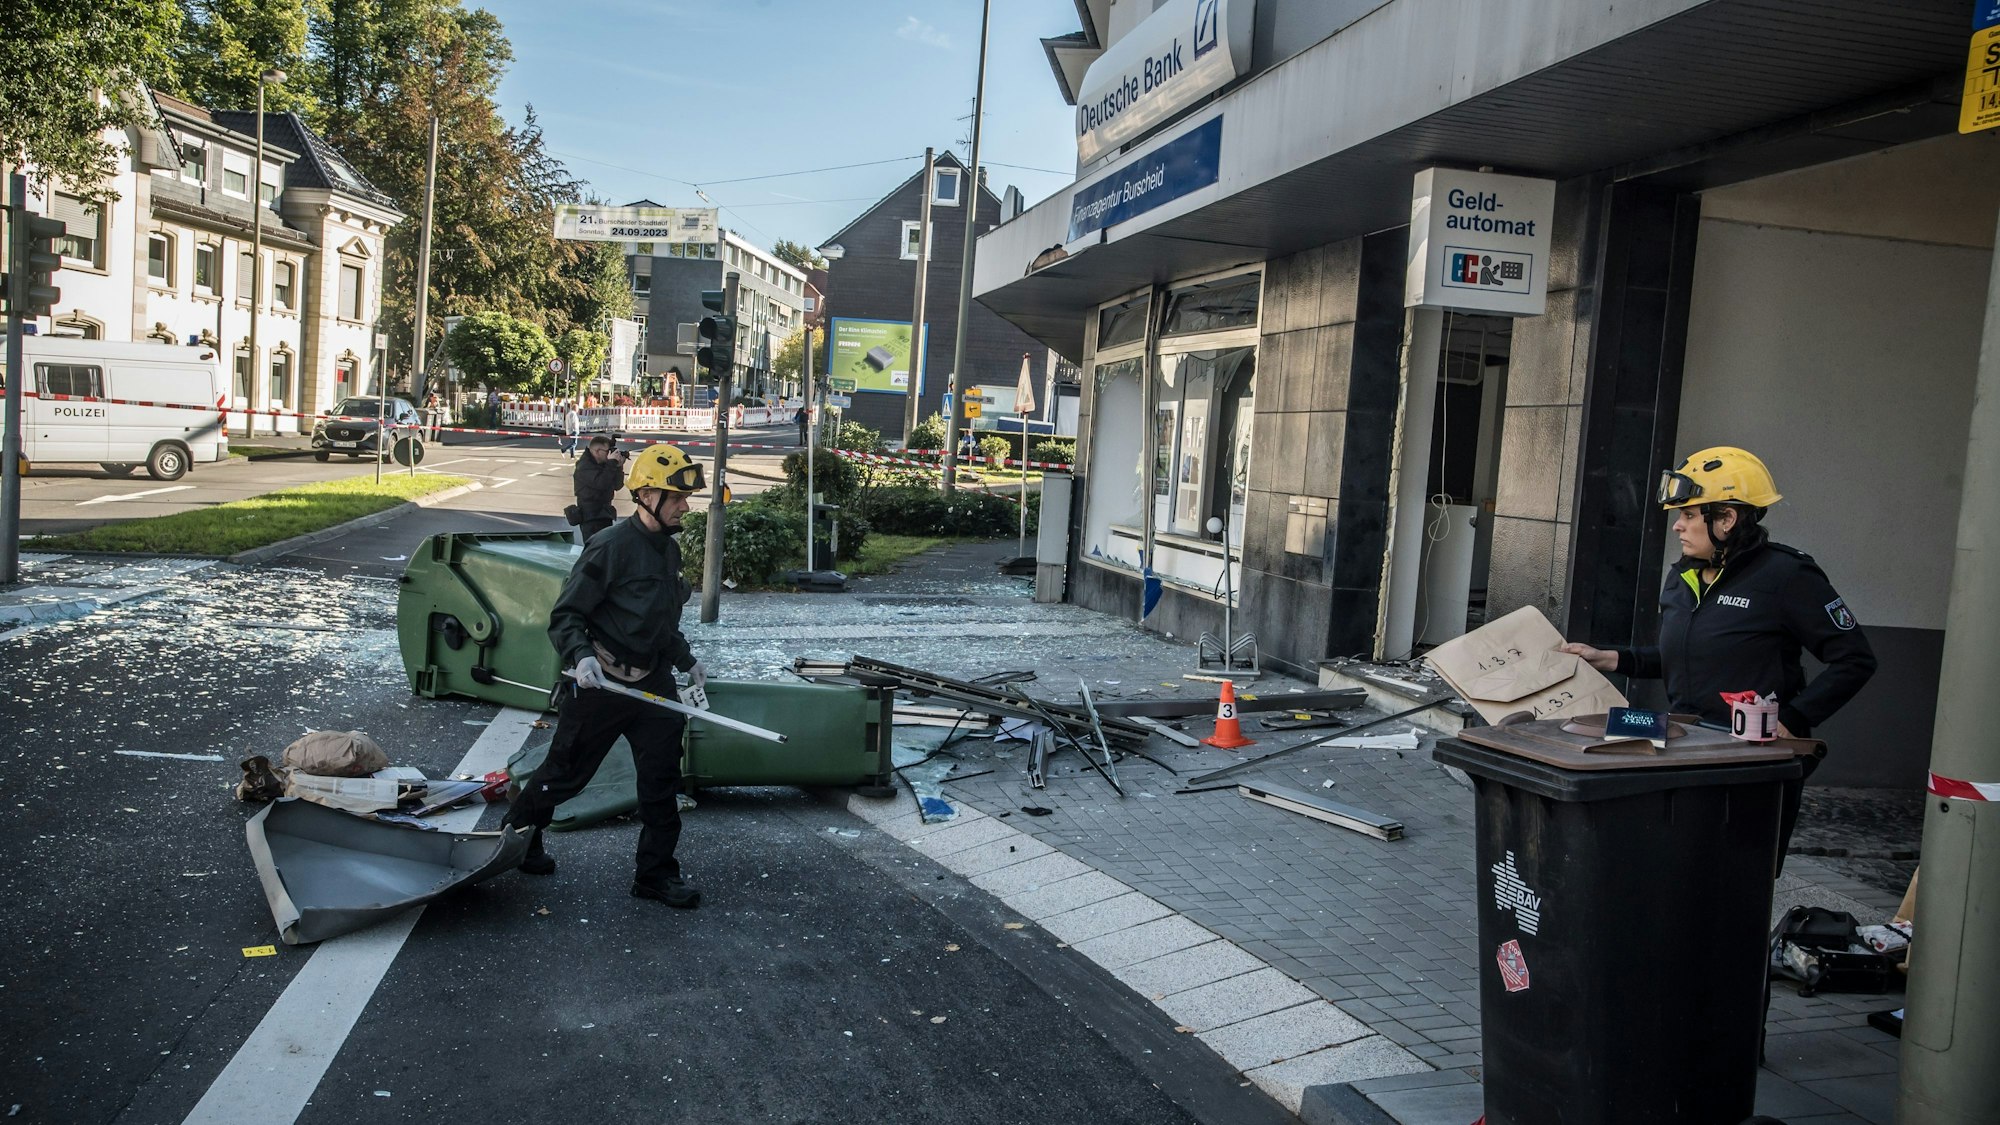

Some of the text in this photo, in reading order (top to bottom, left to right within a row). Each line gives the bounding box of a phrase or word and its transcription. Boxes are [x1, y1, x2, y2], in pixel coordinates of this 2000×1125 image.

[1081, 38, 1184, 136] Deutsche Bank
[1074, 162, 1165, 224] Finanzagentur Burscheid
[1448, 188, 1504, 212] Geld-
[580, 215, 668, 227] 21. Burscheider Stadtlauf
[1446, 214, 1536, 237] automat
[612, 227, 668, 237] 24.09.2023
[54, 407, 105, 418] POLIZEI
[1717, 594, 1751, 609] POLIZEI
[1223, 703, 1233, 718] 3
[1516, 889, 1541, 911] BAV
